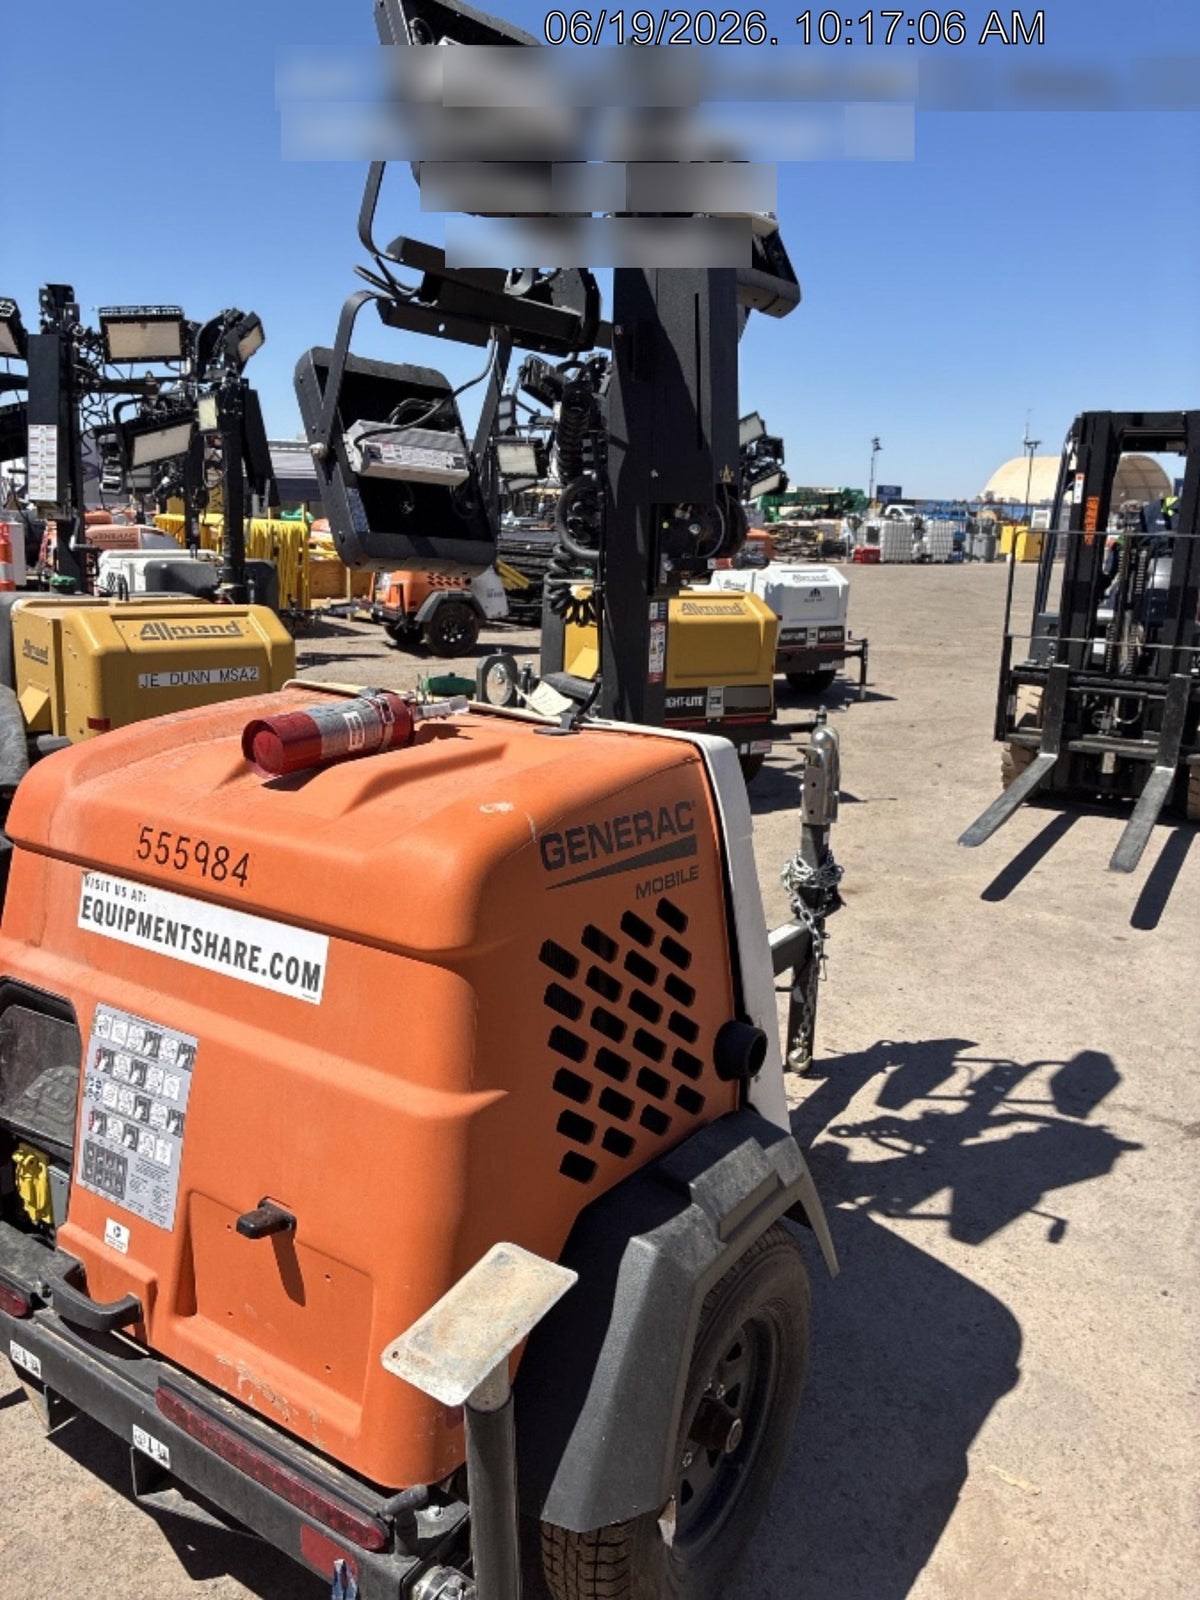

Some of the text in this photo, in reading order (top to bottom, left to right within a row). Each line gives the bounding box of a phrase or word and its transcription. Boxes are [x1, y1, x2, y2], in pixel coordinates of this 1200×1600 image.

[682, 602, 745, 615] Allmand
[140, 619, 244, 640] Allmand
[141, 667, 258, 688] JE DUNN MSA2
[664, 696, 705, 709] IGHT-LITE
[539, 800, 695, 872] GENERAC
[136, 825, 250, 888] 555984
[84, 874, 148, 903] VISIT US AT:
[635, 865, 700, 900] MOBILE
[80, 895, 322, 993] EQUIPMENTSHARE.COM
